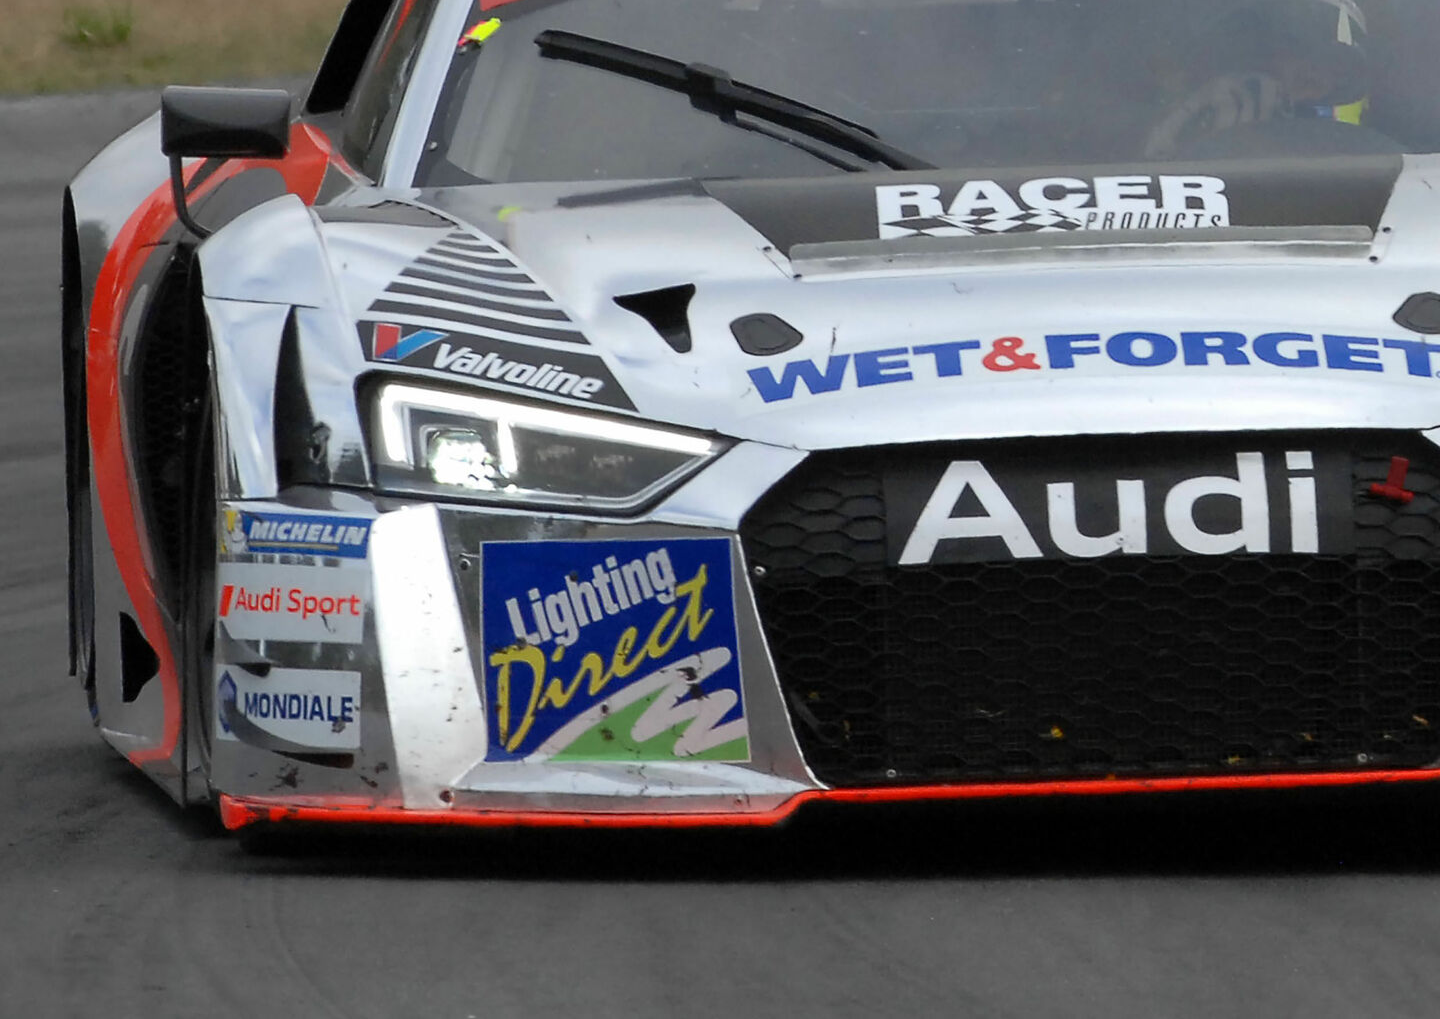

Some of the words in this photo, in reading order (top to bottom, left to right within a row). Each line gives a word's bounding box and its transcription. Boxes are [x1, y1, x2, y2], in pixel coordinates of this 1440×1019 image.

[876, 175, 1229, 220] RACER
[433, 342, 604, 400] Valvoline
[250, 520, 368, 546] MICHELIN
[899, 451, 1320, 567] Audi
[235, 587, 281, 612] Audi
[287, 588, 361, 619] Sport
[506, 547, 677, 647] Lighting
[491, 564, 714, 753] Direct
[244, 692, 354, 722] MONDIALE
